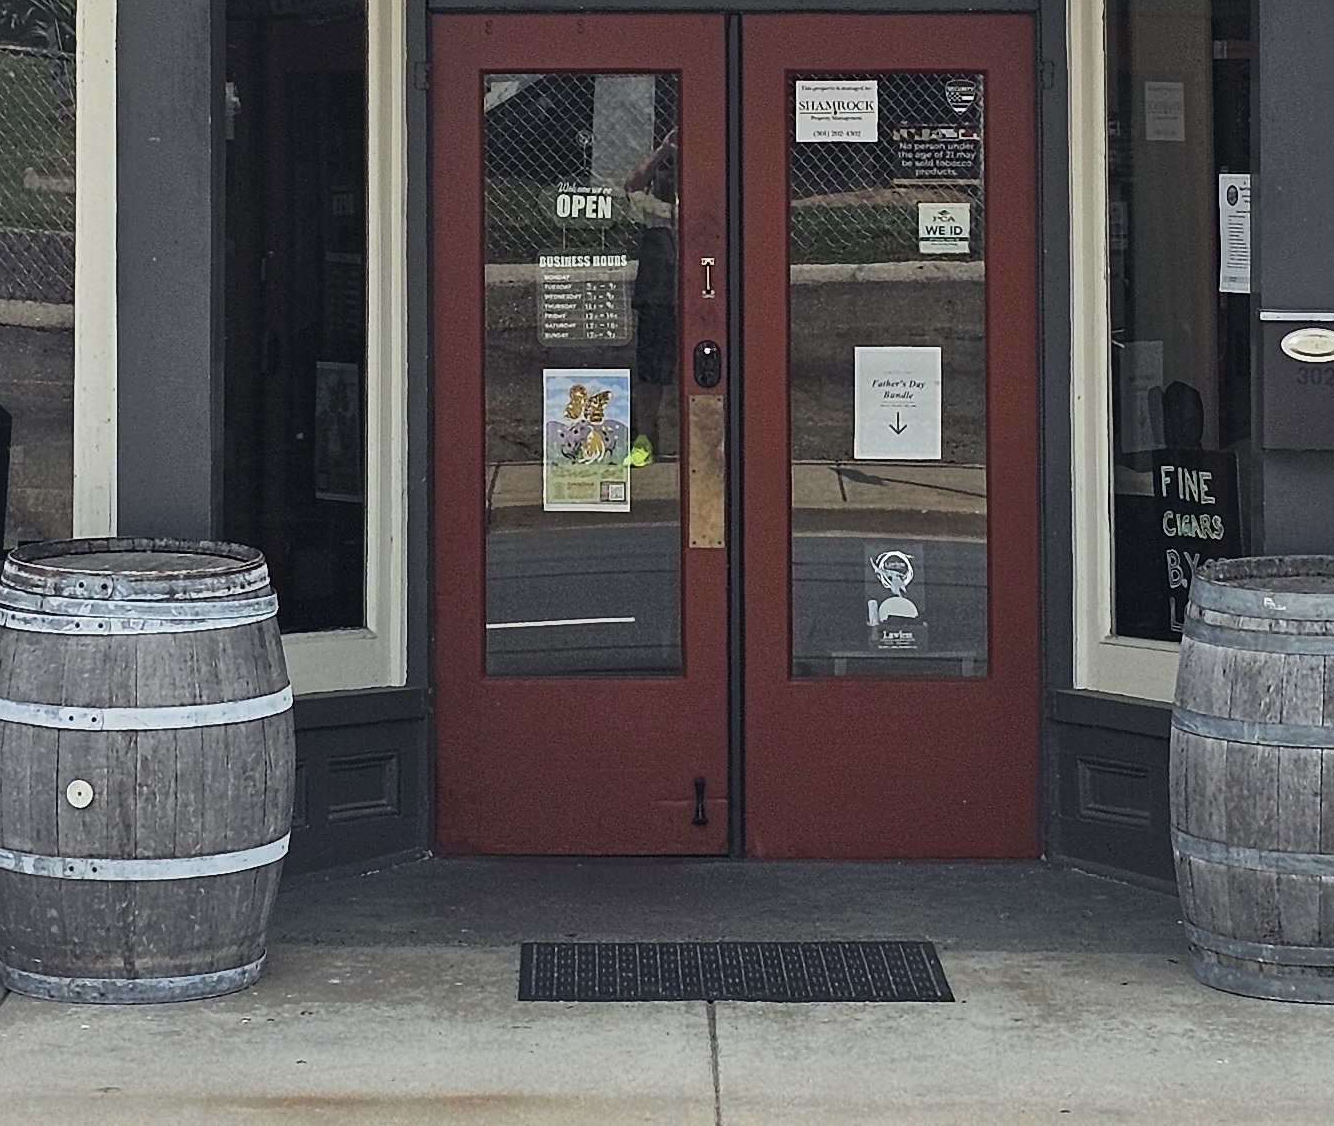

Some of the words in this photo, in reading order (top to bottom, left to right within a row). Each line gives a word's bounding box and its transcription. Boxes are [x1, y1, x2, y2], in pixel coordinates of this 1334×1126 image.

[798, 100, 875, 111] SHAMROCK
[899, 142, 913, 150] No
[914, 143, 946, 151] person
[947, 142, 975, 150] under
[914, 152, 932, 160] age
[956, 152, 976, 160] may
[556, 194, 612, 219] OPEN
[925, 225, 946, 236] WE
[949, 225, 963, 236] ID
[539, 255, 591, 268] BUSINESS
[592, 255, 628, 267] HOURS
[872, 379, 906, 388] Father's
[909, 379, 926, 390] Day
[883, 391, 914, 399] Bundle
[1160, 465, 1216, 504] FINE
[1162, 510, 1225, 540] CIGARS
